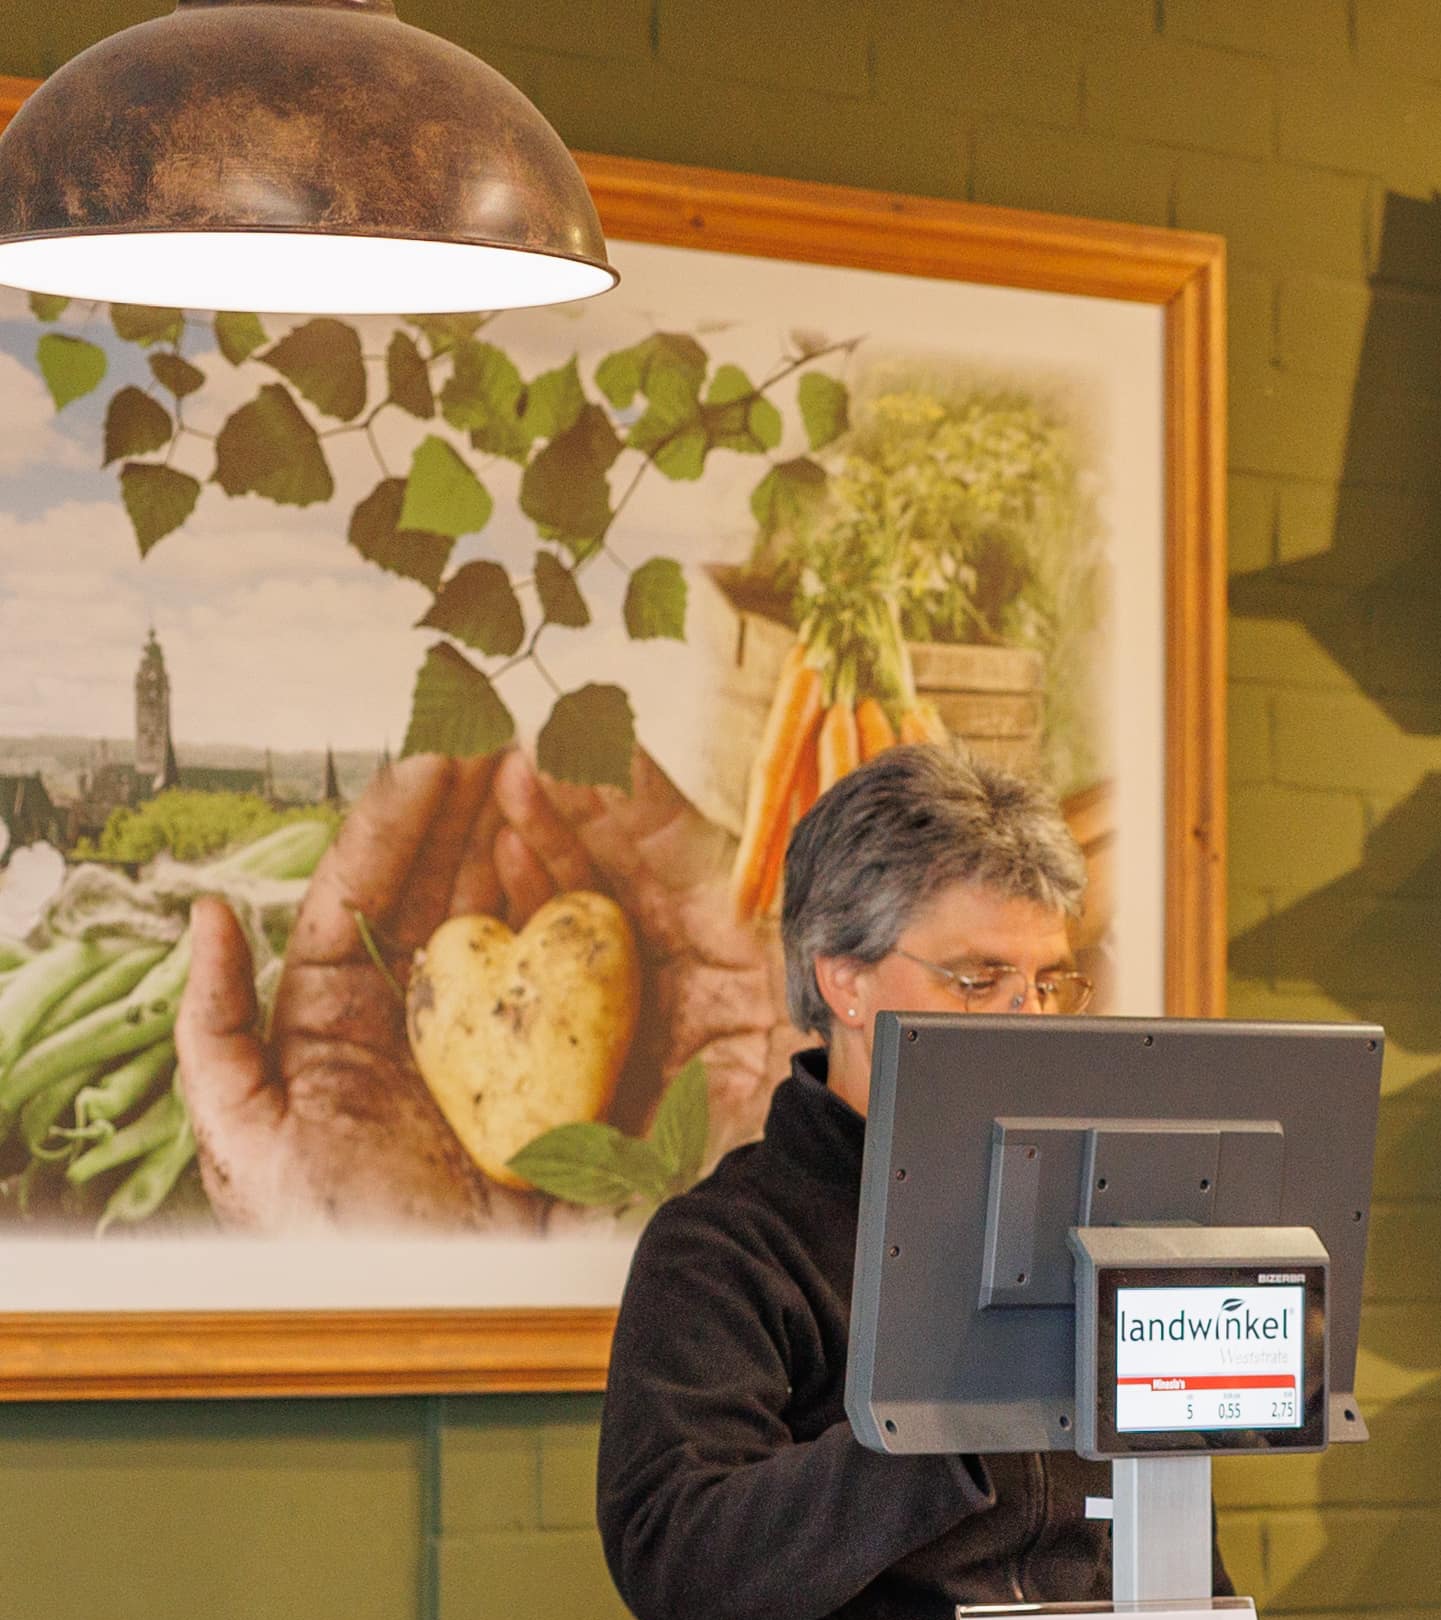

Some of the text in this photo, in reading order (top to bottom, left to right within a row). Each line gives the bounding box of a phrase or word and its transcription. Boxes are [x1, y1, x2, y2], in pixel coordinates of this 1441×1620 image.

[1120, 1298, 1288, 1342] landwinkel
[1220, 1347, 1288, 1365] Weststrate
[1186, 1403, 1194, 1419] 5
[1271, 1402, 1294, 1419] 2,75
